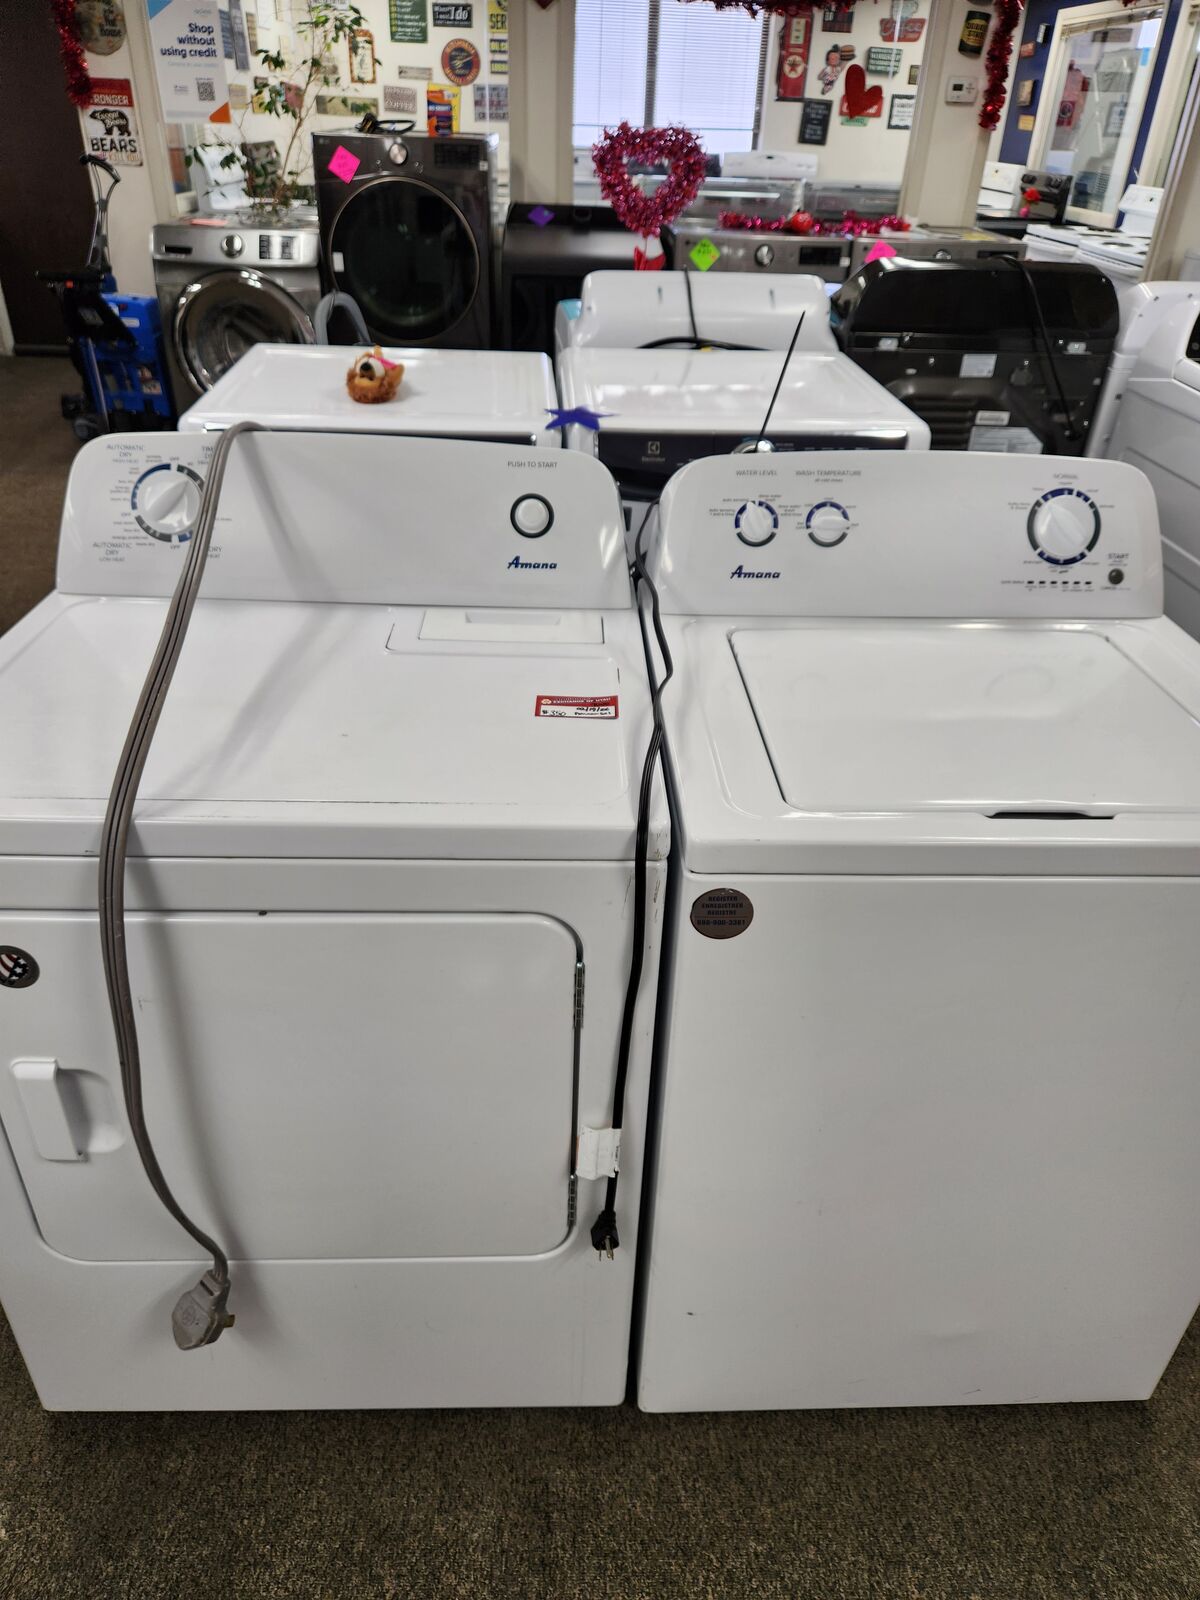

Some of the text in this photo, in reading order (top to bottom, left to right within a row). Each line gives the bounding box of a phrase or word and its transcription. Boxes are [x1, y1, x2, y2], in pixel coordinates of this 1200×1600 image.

[188, 22, 214, 35] Shop
[177, 34, 216, 46] without
[160, 46, 217, 59] using credit
[91, 137, 137, 153] BEARS
[538, 461, 558, 469] START
[507, 555, 558, 569] Amana
[730, 564, 781, 579] Amana
